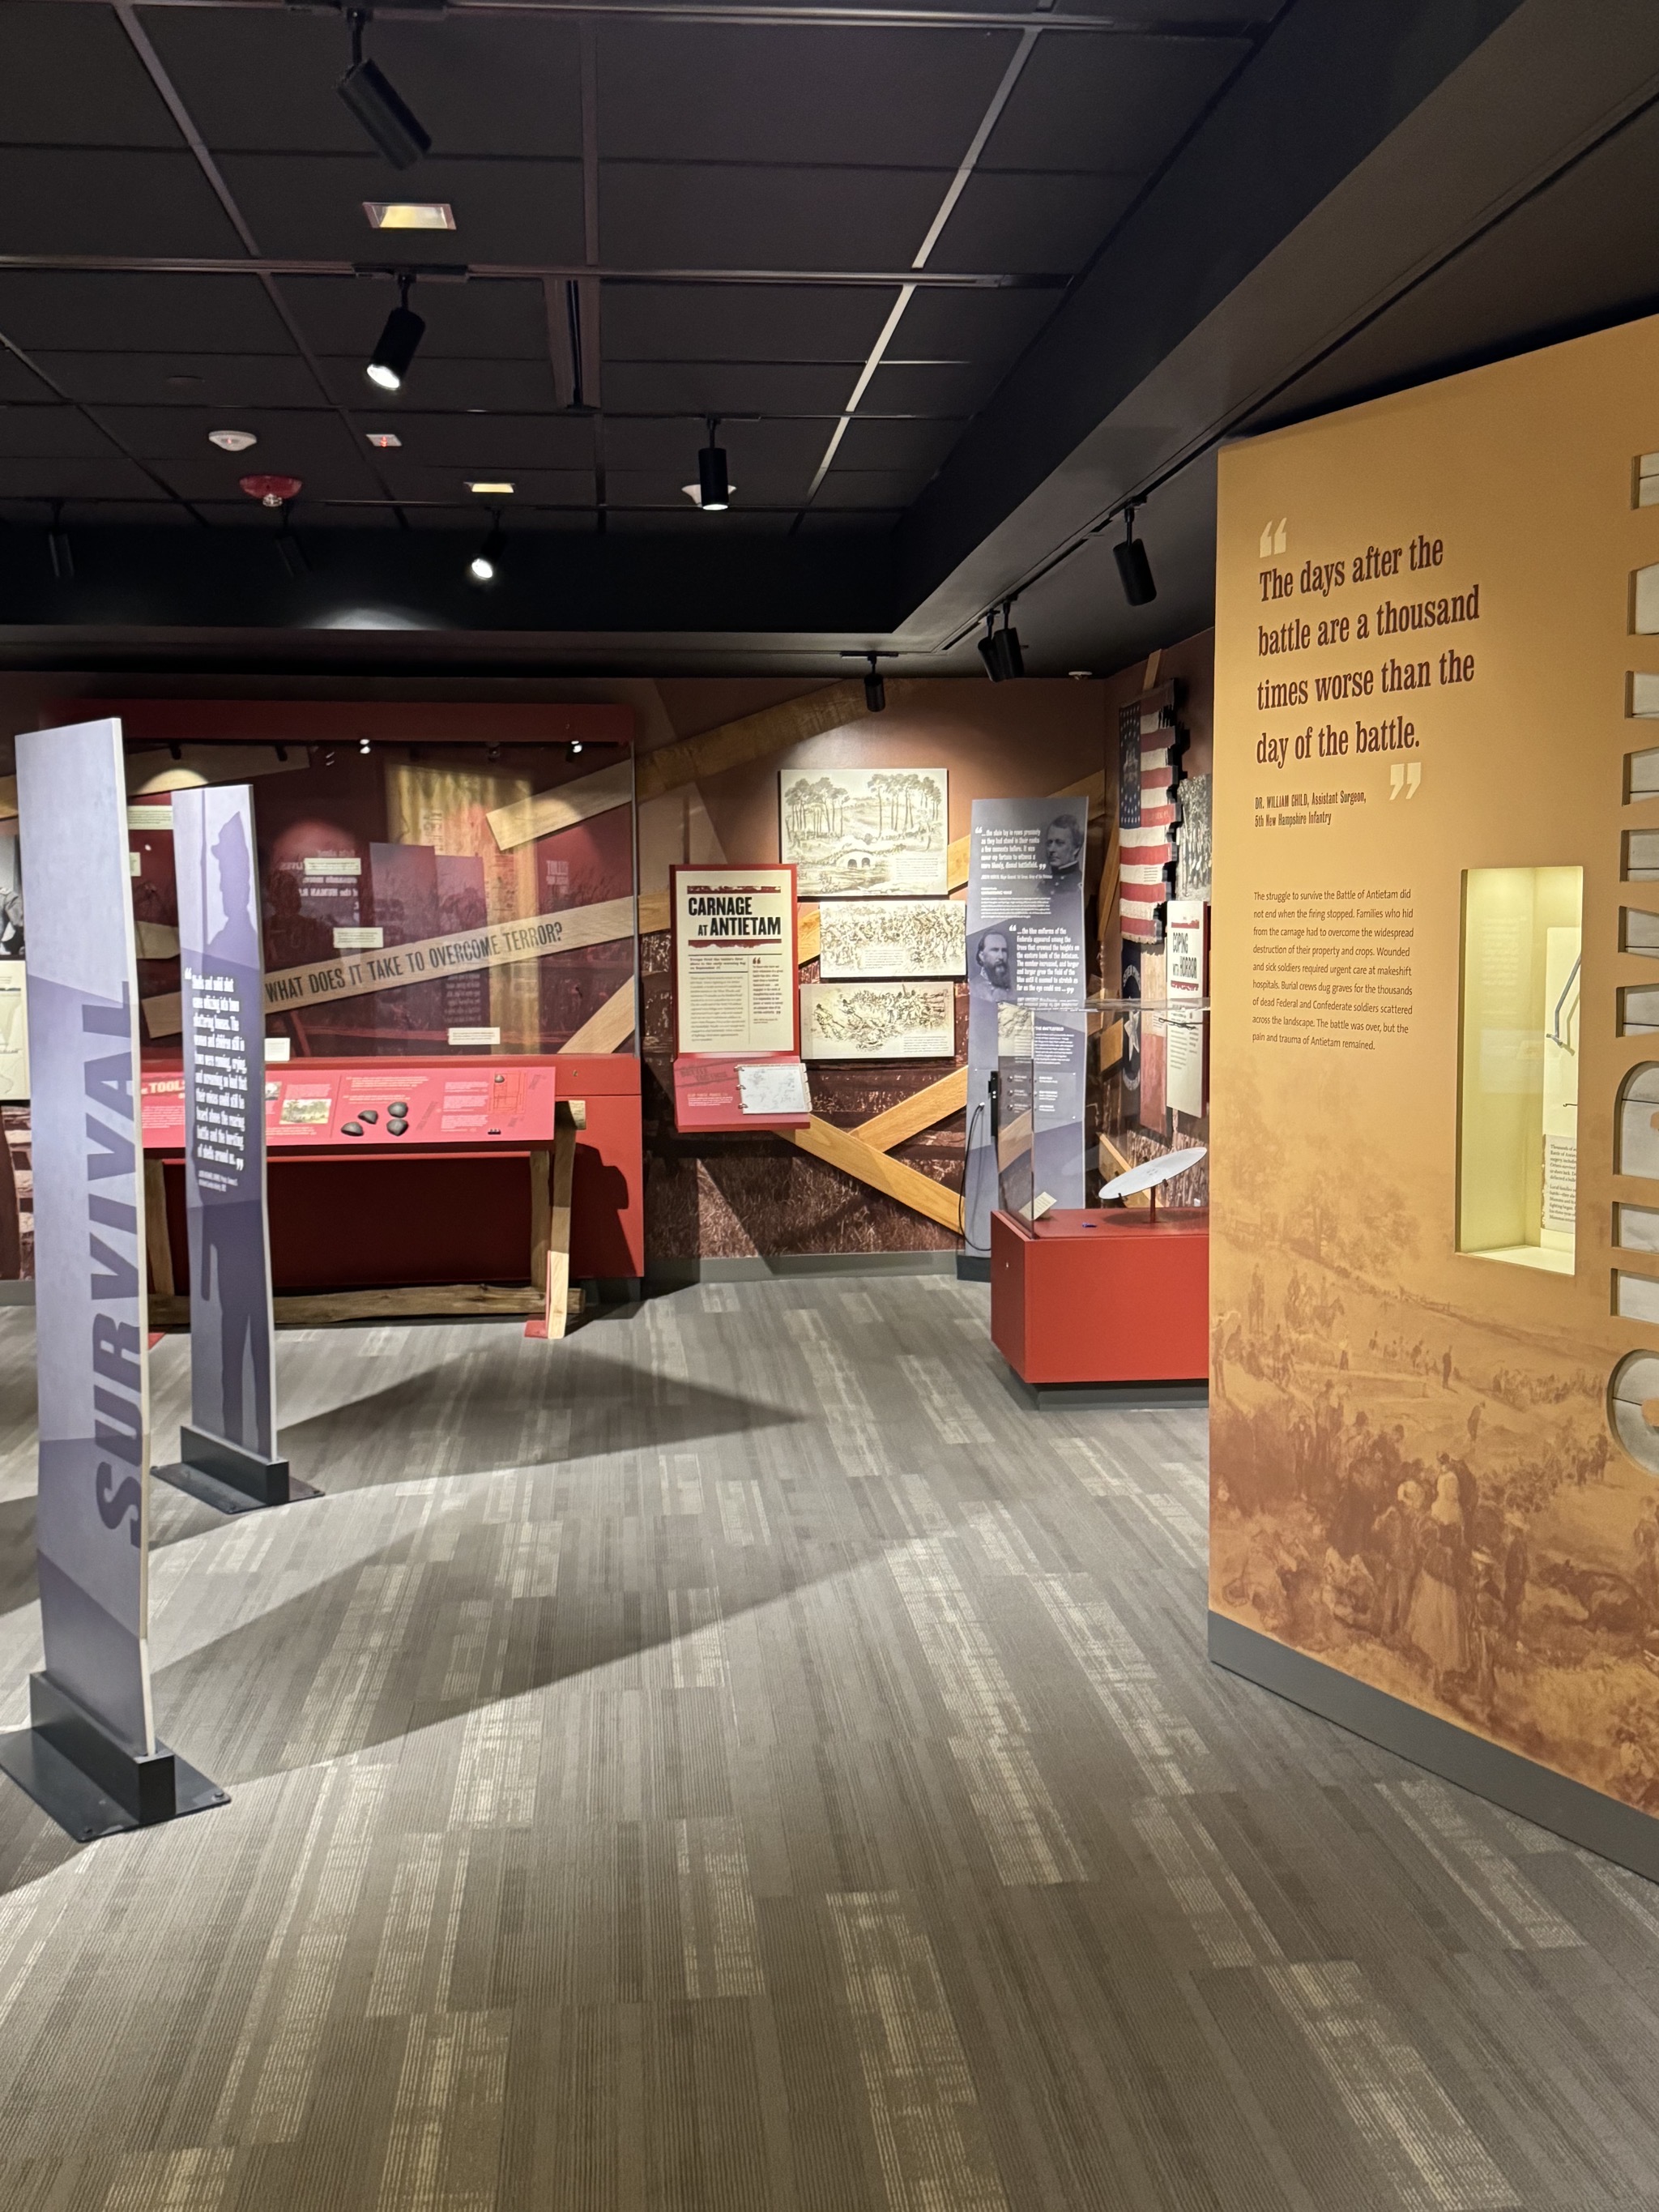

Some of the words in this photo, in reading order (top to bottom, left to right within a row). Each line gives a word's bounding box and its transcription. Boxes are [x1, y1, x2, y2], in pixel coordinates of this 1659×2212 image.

[1260, 568, 1294, 602] The
[1300, 561, 1345, 597] days
[1353, 545, 1402, 583] after
[1410, 535, 1444, 572] the
[1258, 619, 1311, 656] battle
[1318, 616, 1350, 647] are
[1357, 614, 1369, 639] a
[1377, 584, 1479, 636] thousand
[1257, 677, 1308, 711] times
[1316, 668, 1374, 702] worse
[1381, 659, 1431, 694] than
[1439, 650, 1474, 686] the
[1257, 732, 1289, 769] day
[1294, 725, 1312, 760] of
[1318, 724, 1349, 758] the
[1356, 715, 1420, 754] battle.
[1256, 797, 1264, 809] DR.
[1267, 795, 1289, 808] WILLIAM
[1291, 793, 1309, 807] CHILD,
[1311, 792, 1338, 805] Assistant
[1341, 791, 1366, 805] Surgeon,
[1255, 815, 1264, 827] 5th
[1266, 814, 1276, 826] New
[1278, 813, 1306, 827] Hampshire
[1309, 811, 1332, 825] Infantry
[1254, 891, 1265, 900] The
[1266, 891, 1290, 903] struggle
[1293, 892, 1299, 900] to
[1301, 891, 1322, 900] survive
[1324, 890, 1335, 899] the
[1337, 890, 1355, 899] Battle
[1358, 890, 1365, 899] of
[1366, 890, 1398, 899] Antietam
[1400, 889, 1411, 899] did
[689, 897, 753, 916] CARNAGE
[1254, 910, 1264, 918] not
[1265, 909, 1277, 918] end
[1278, 909, 1295, 918] when
[1297, 909, 1307, 918] the
[1309, 908, 1325, 921] firing
[1327, 908, 1355, 920] stopped.
[1357, 909, 1383, 918] Families
[1385, 908, 1401, 918] who
[1402, 908, 1414, 918] hid
[698, 925, 708, 936] AT
[710, 917, 781, 936] ANTIETAM
[1254, 927, 1268, 936] from
[1269, 927, 1279, 936] the
[1281, 929, 1304, 939] carnage
[1307, 928, 1318, 936] had
[1362, 928, 1372, 937] the
[1375, 928, 1414, 940] widespread
[1173, 932, 1188, 954] COPING
[1253, 944, 1286, 954] destruction
[1288, 945, 1295, 954] of
[1296, 946, 1311, 954] their
[1312, 946, 1340, 958] property
[1341, 946, 1354, 955] and
[1355, 947, 1375, 958] crops.
[1377, 947, 1410, 956] Wounded
[265, 976, 304, 1003] WHAT
[309, 968, 346, 993] DOES
[348, 964, 363, 985] IT
[368, 956, 404, 981] TAKE
[406, 951, 424, 972] TO
[429, 935, 501, 968] OVERCOME
[503, 922, 562, 952] TERROR?
[1179, 956, 1197, 979] HORROR
[1253, 963, 1265, 971] and
[1265, 963, 1277, 971] sick
[1278, 963, 1301, 972] soldiers
[1303, 964, 1328, 975] required
[1330, 966, 1351, 976] urgent
[1368, 967, 1375, 975] at
[1378, 966, 1412, 976] makeshift
[1253, 980, 1280, 991] hospitals.
[1282, 981, 1298, 990] Burial
[1318, 982, 1330, 995] dug
[1332, 984, 1353, 995] graves
[1354, 984, 1363, 993] for
[1365, 984, 1376, 993] the
[1378, 984, 1413, 995] thousands
[1252, 997, 1259, 1006] of
[1260, 997, 1275, 1006] dead
[1277, 998, 1299, 1008] Federal
[1299, 1000, 1311, 1009] and
[1313, 1001, 1352, 1011] Confederate
[1354, 1002, 1379, 1013] soldiers
[1380, 1005, 1413, 1014] scattered
[1252, 1016, 1270, 1024] across
[1272, 1016, 1282, 1025] the
[1283, 1017, 1315, 1029] landscape.
[1316, 1018, 1328, 1027] The
[1330, 1019, 1349, 1030] battle
[1350, 1023, 1364, 1031] was
[1366, 1024, 1381, 1034] over,
[1384, 1023, 1395, 1033] but
[1397, 1024, 1409, 1034] the
[1252, 1032, 1265, 1043] pain
[1267, 1034, 1277, 1042] and
[1279, 1035, 1301, 1044] trauma
[1303, 1036, 1310, 1045] of
[1311, 1036, 1340, 1048] Antietam
[1342, 1040, 1375, 1050] remained.
[83, 981, 143, 1549] SURVIVAL
